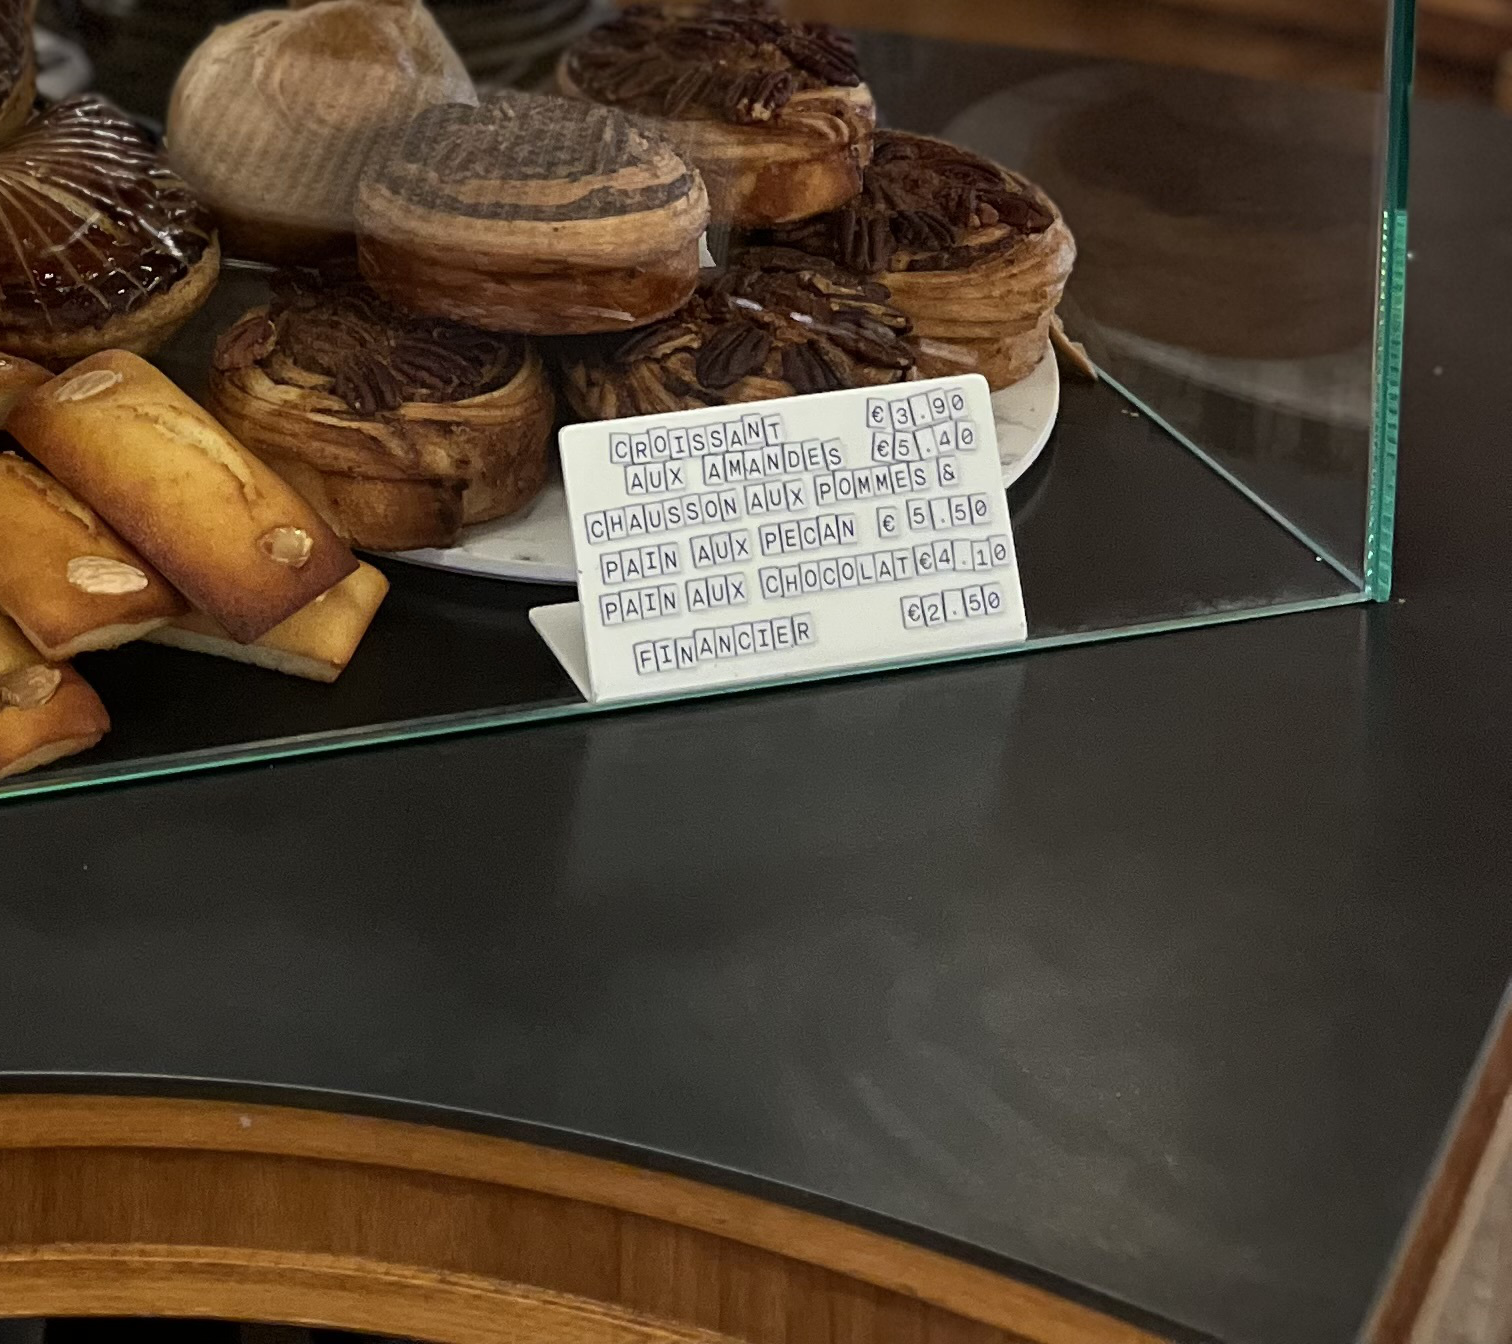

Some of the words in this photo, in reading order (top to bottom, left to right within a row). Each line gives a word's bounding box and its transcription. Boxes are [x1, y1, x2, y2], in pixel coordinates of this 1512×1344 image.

[615, 420, 781, 459] CROISSANT
[870, 393, 965, 425] €3.90
[631, 470, 684, 490] AUX
[708, 447, 842, 480] AMANDES
[876, 428, 974, 458] €5.40
[590, 496, 736, 539] CHAUSSON
[750, 485, 804, 507] AUX
[820, 468, 926, 499] POMMES
[941, 463, 956, 482] &
[606, 551, 678, 579] PAIN
[698, 538, 749, 562] AUX
[766, 517, 855, 549] PECAN
[606, 593, 677, 619] PAIN
[692, 581, 745, 605] AUX
[766, 556, 910, 594] CHOCOLAT
[919, 541, 1007, 570] €4.10
[640, 620, 811, 667] FINANCIER
[907, 593, 1001, 623] €2.50
